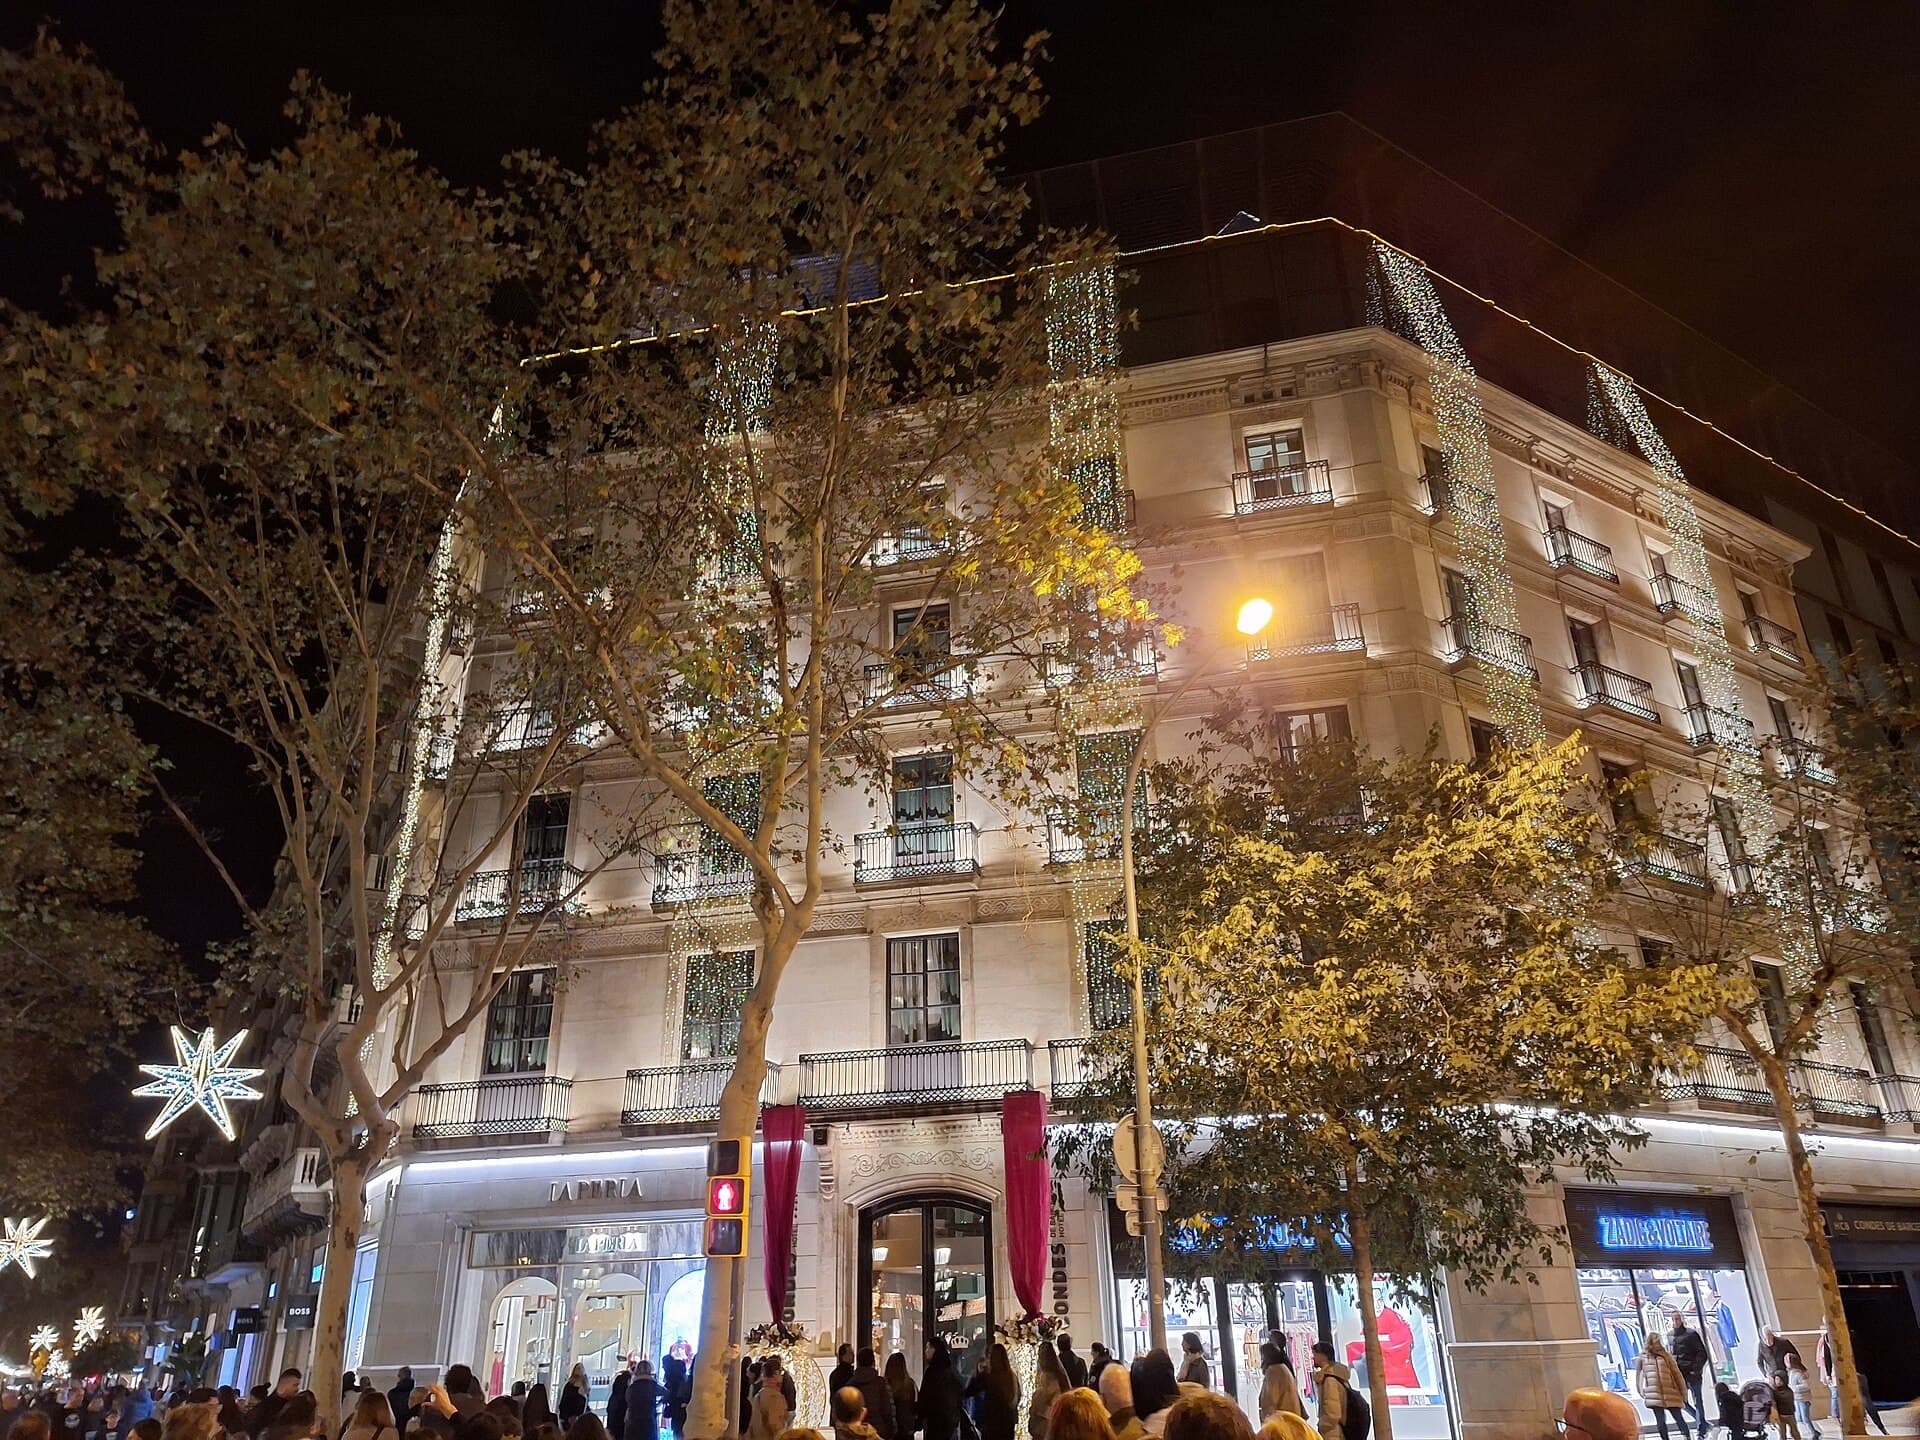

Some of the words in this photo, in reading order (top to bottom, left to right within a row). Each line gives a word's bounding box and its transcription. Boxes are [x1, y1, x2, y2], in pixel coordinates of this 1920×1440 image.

[549, 1181, 572, 1201] LA
[577, 1177, 643, 1199] PERLA
[1051, 1243, 1070, 1326] ONDES
[289, 1307, 311, 1316] BOSS
